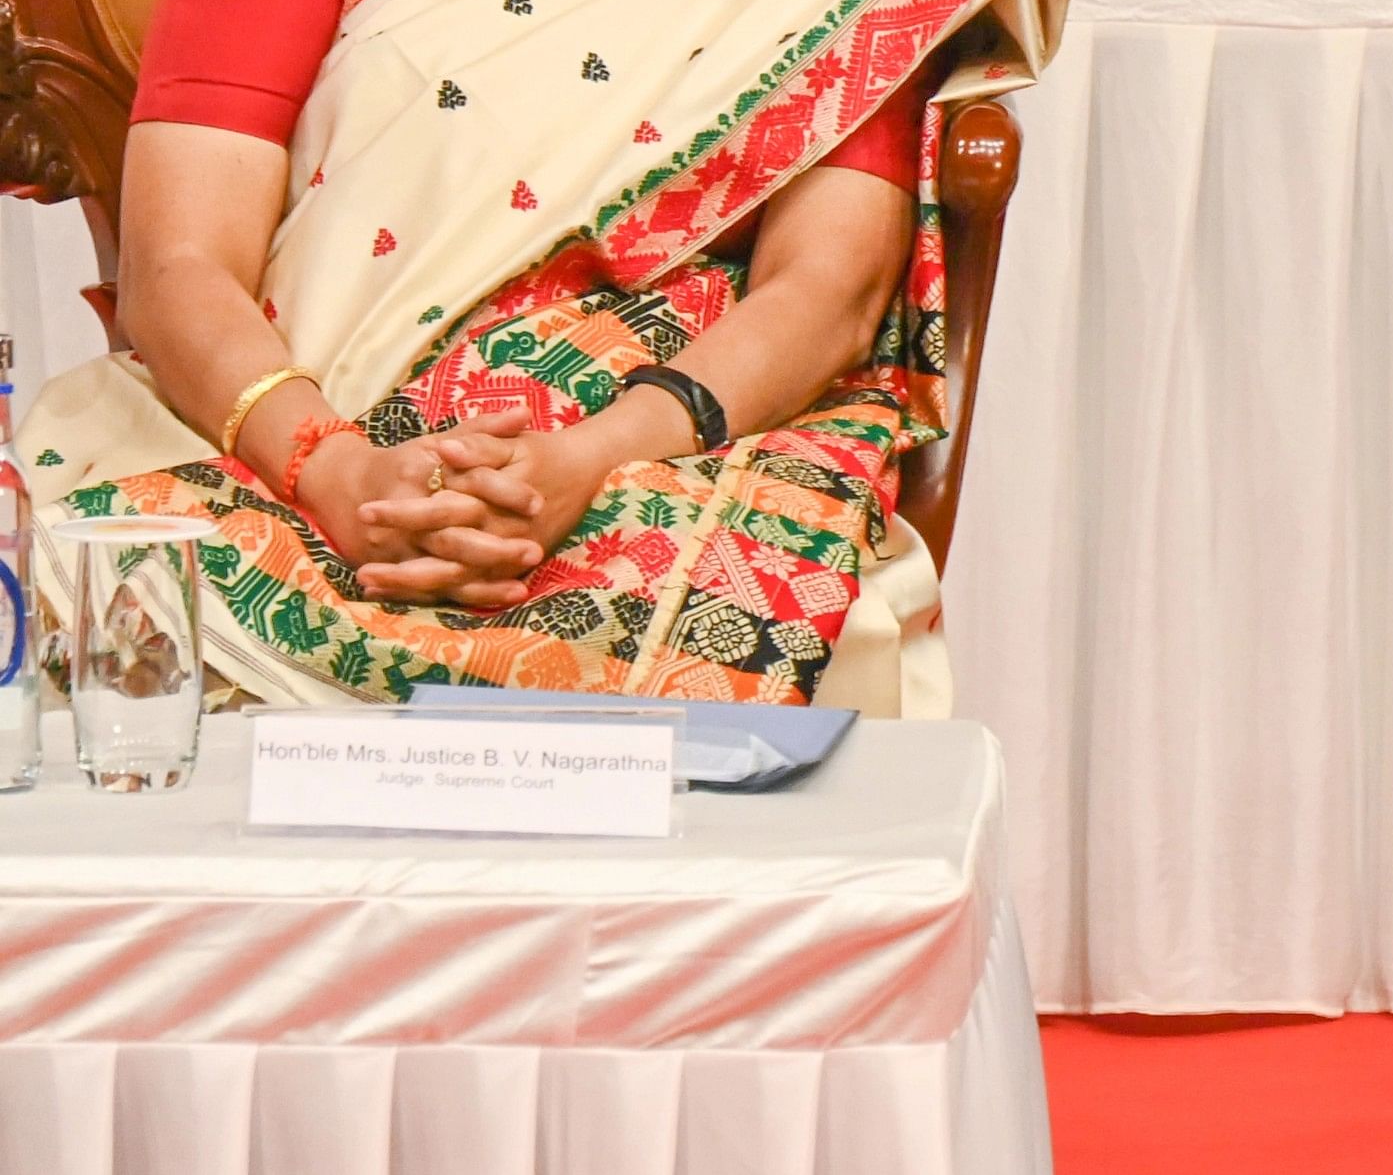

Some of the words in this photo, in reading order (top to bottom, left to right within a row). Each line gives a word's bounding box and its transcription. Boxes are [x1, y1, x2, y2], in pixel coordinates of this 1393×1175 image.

[259, 742, 339, 762] Hon'ble
[346, 744, 391, 764] Mrs.
[400, 746, 475, 766] Justice
[484, 750, 504, 768] B.
[513, 751, 532, 769] V.
[542, 751, 667, 774] Nagarathna
[375, 771, 424, 787] Judge
[435, 772, 505, 790] Supreme
[511, 775, 555, 791] Court
